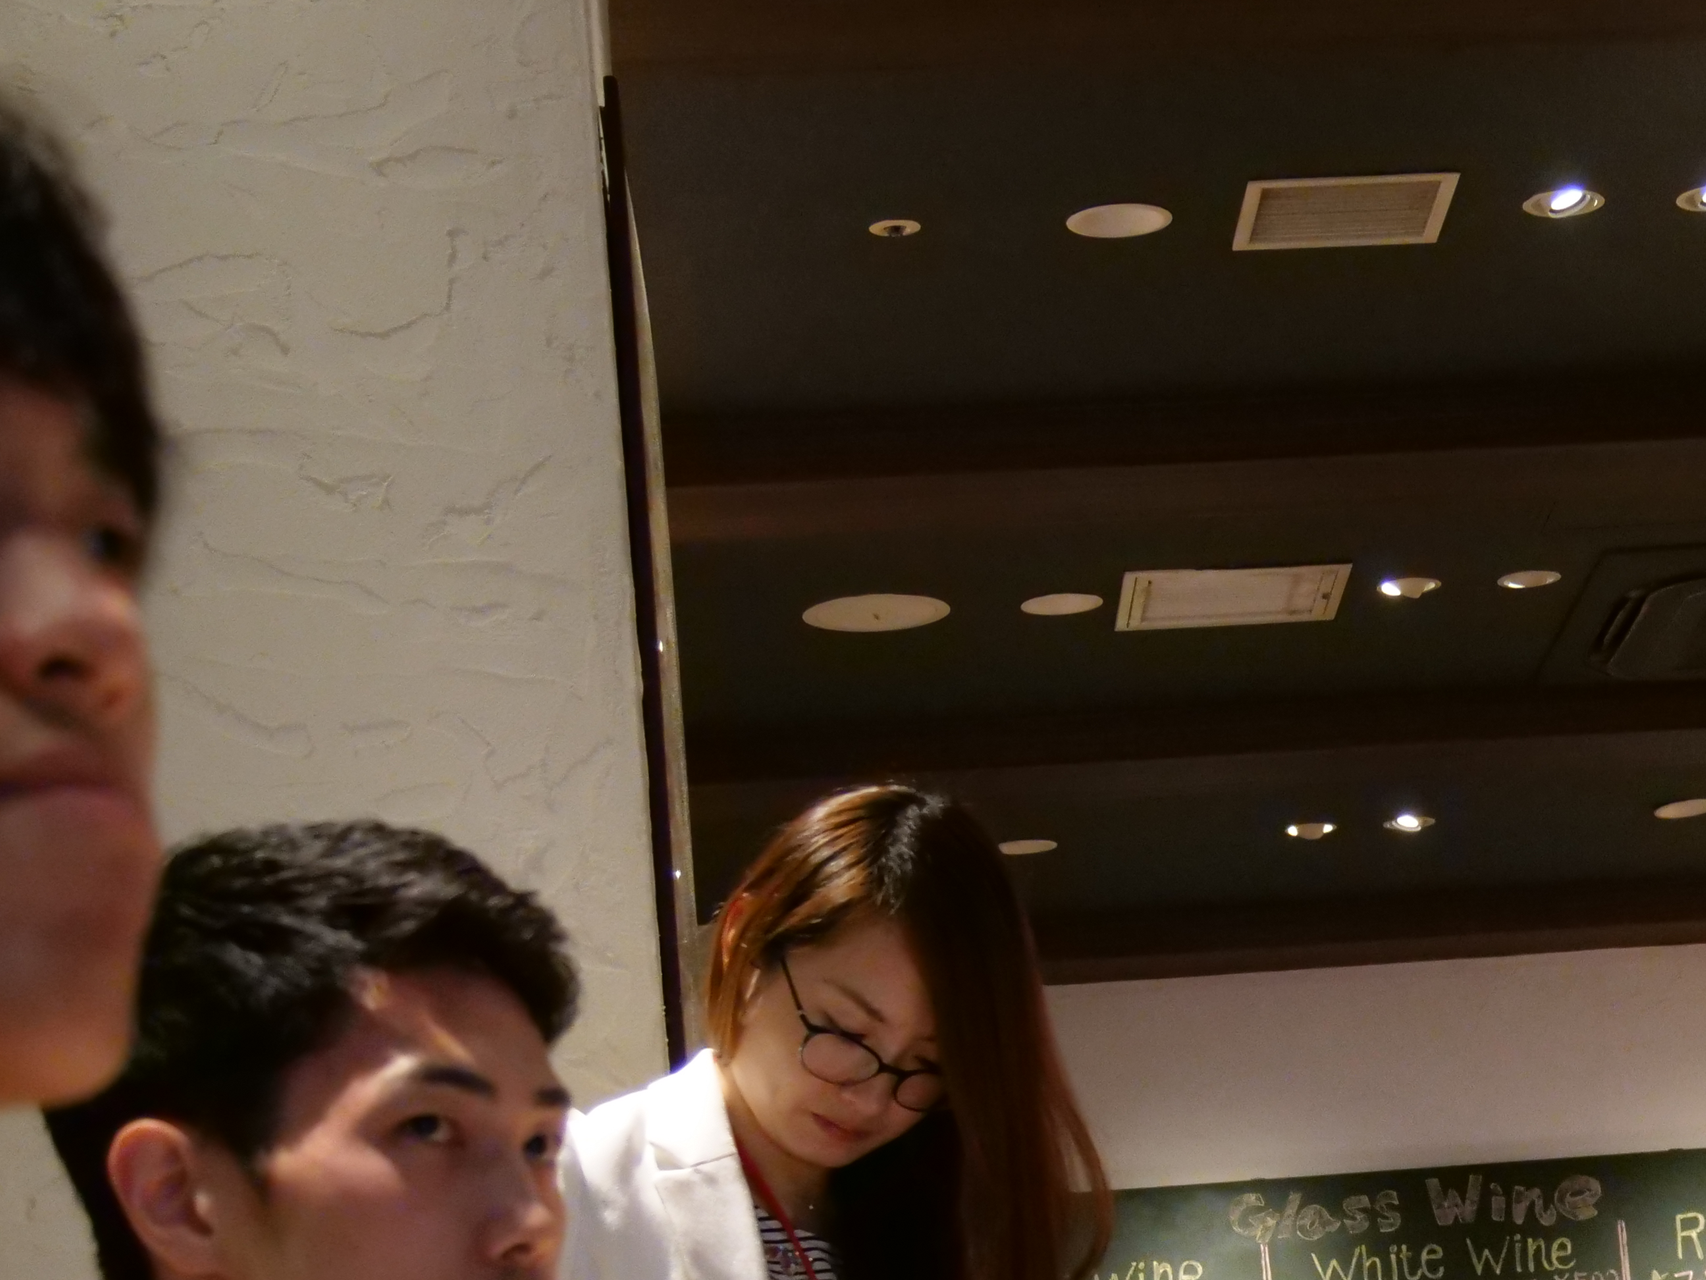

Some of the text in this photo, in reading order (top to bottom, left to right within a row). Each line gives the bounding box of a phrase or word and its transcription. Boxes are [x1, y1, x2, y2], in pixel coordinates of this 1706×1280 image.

[1230, 1174, 1602, 1243] Glass Wine
[1465, 1234, 1576, 1276] Wine
